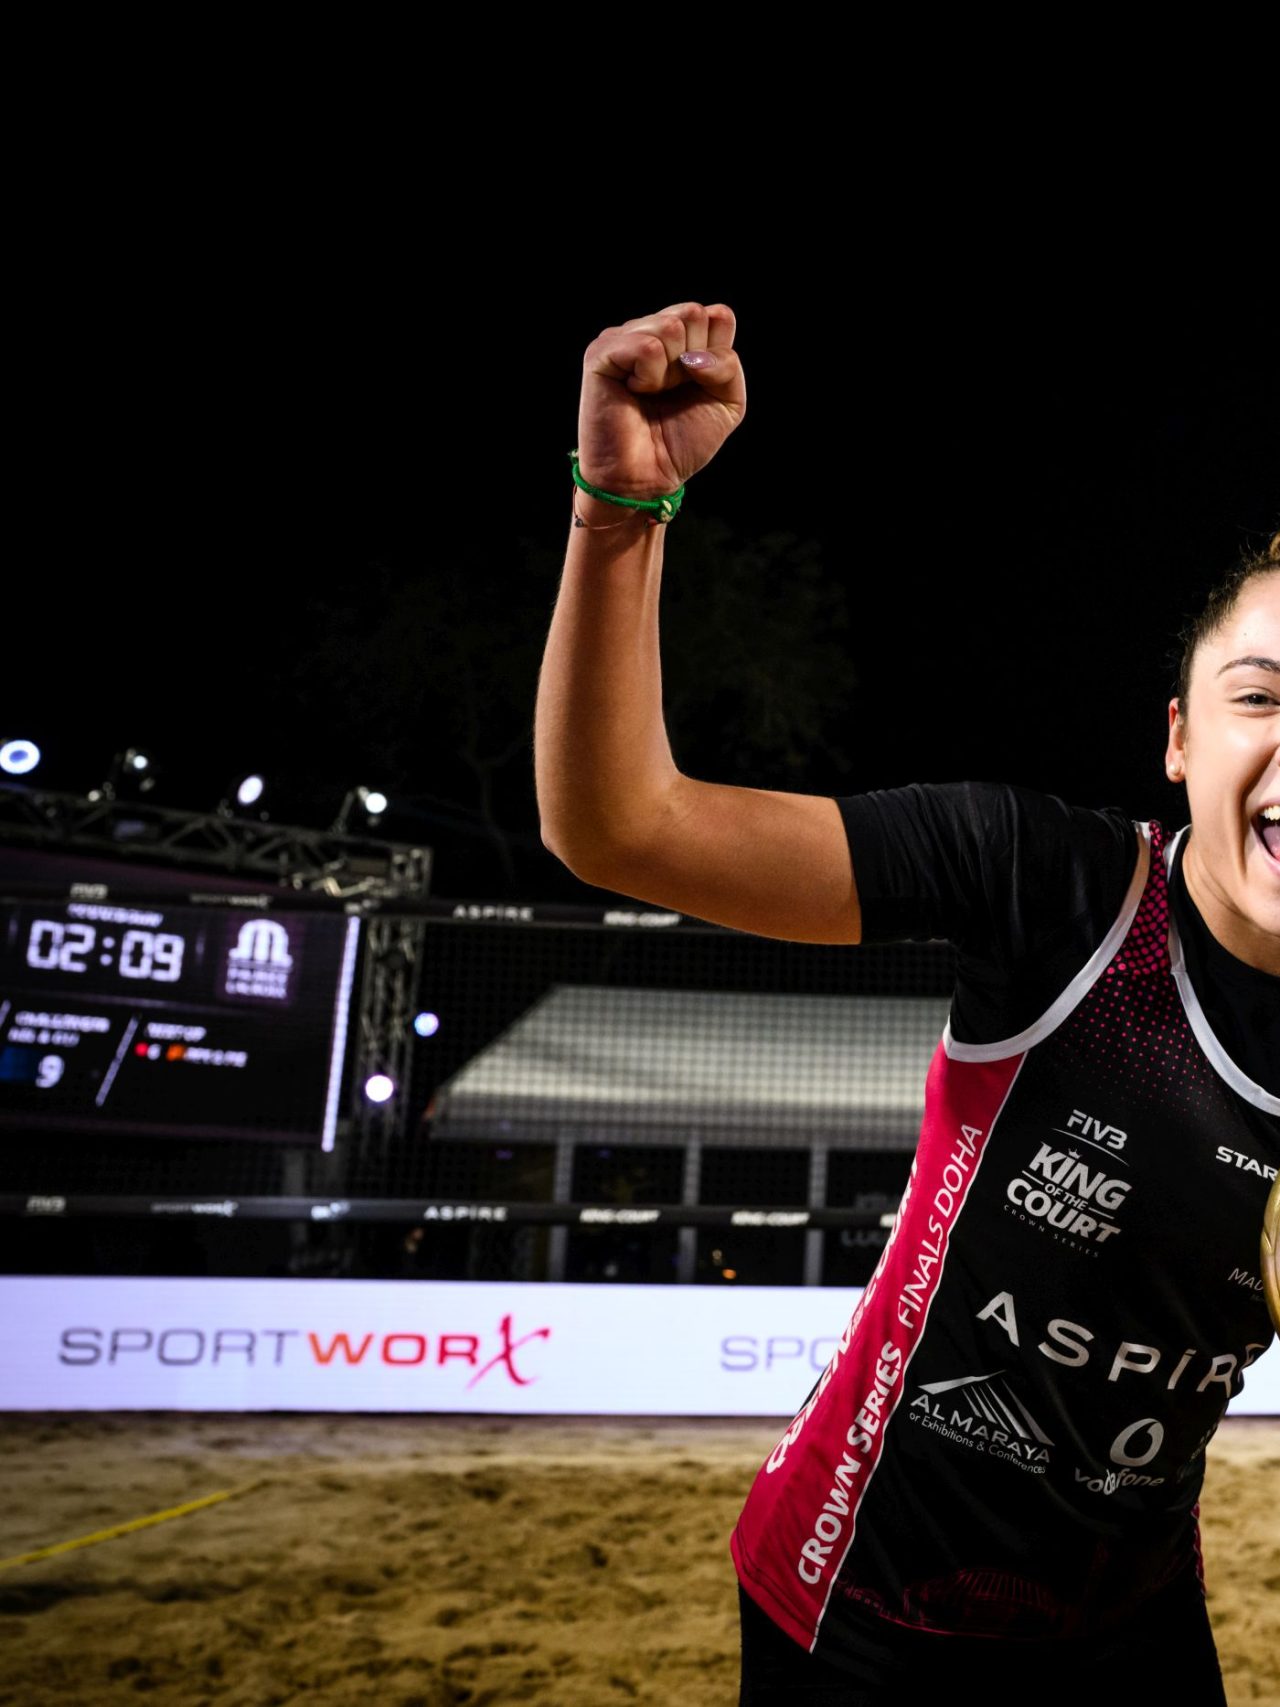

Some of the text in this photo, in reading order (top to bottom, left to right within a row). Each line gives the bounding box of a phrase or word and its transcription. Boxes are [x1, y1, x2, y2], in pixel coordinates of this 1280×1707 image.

[453, 906, 533, 920] ASPIRE
[27, 919, 185, 982] 02:09
[1028, 1141, 1132, 1211] KING
[1215, 1145, 1279, 1181] STAR
[424, 1207, 507, 1221] ASPIRE
[1006, 1178, 1121, 1243] COURT
[1044, 1182, 1089, 1212] OF THE
[1004, 1204, 1045, 1232] CROWN
[799, 1124, 983, 1585] CROWN SERIES FINALS DOHA
[922, 1415, 975, 1448] Exhibitions
[976, 1441, 985, 1452] &
